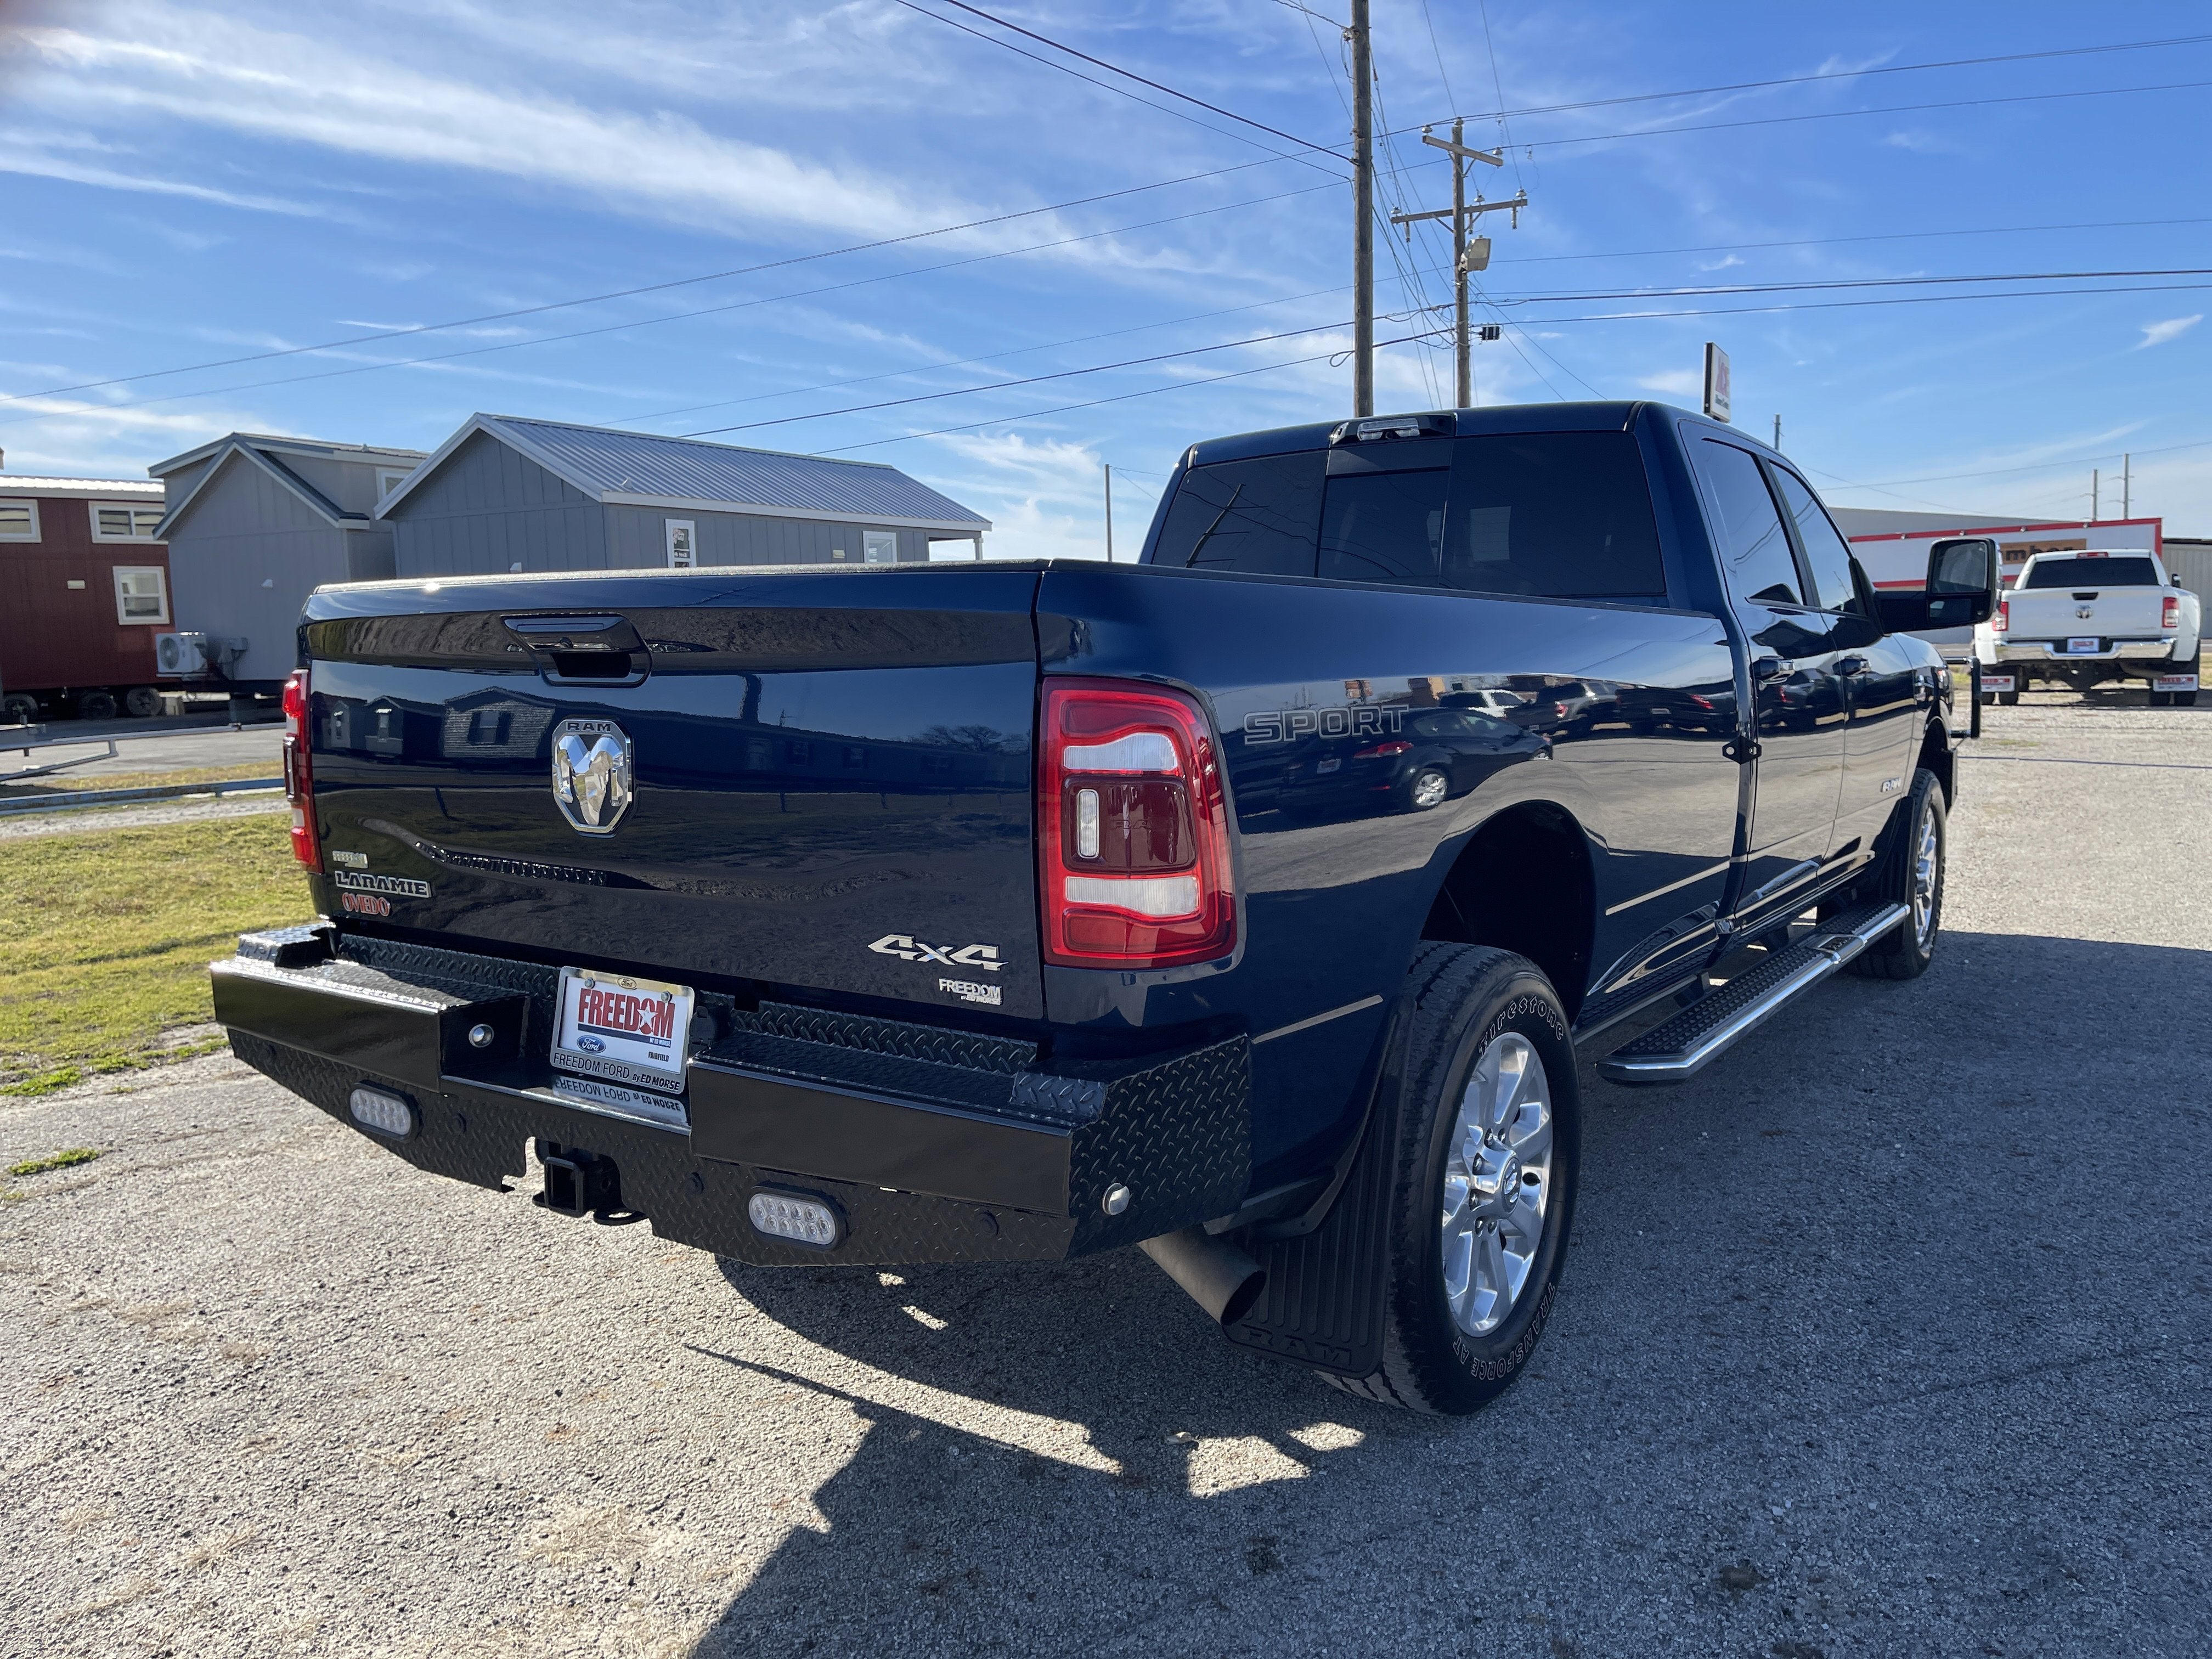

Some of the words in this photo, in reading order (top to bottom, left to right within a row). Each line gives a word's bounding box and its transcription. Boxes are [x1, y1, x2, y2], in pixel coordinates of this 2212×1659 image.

[566, 721, 612, 732] RAM
[1244, 704, 1409, 745] SPORT
[335, 871, 432, 898] LARAMIE
[342, 892, 391, 917] OVIEDO
[939, 978, 1003, 1000] FREEDOM
[578, 988, 676, 1039] FREEDOM
[1479, 994, 1564, 1056] Firestone
[553, 1052, 600, 1073] FREEDOM
[603, 1062, 630, 1080] FORD
[640, 1074, 651, 1083] ED
[651, 1076, 680, 1091] MORSE
[1471, 1282, 1556, 1380] TRANSFORCE
[1453, 1336, 1470, 1365] AT
